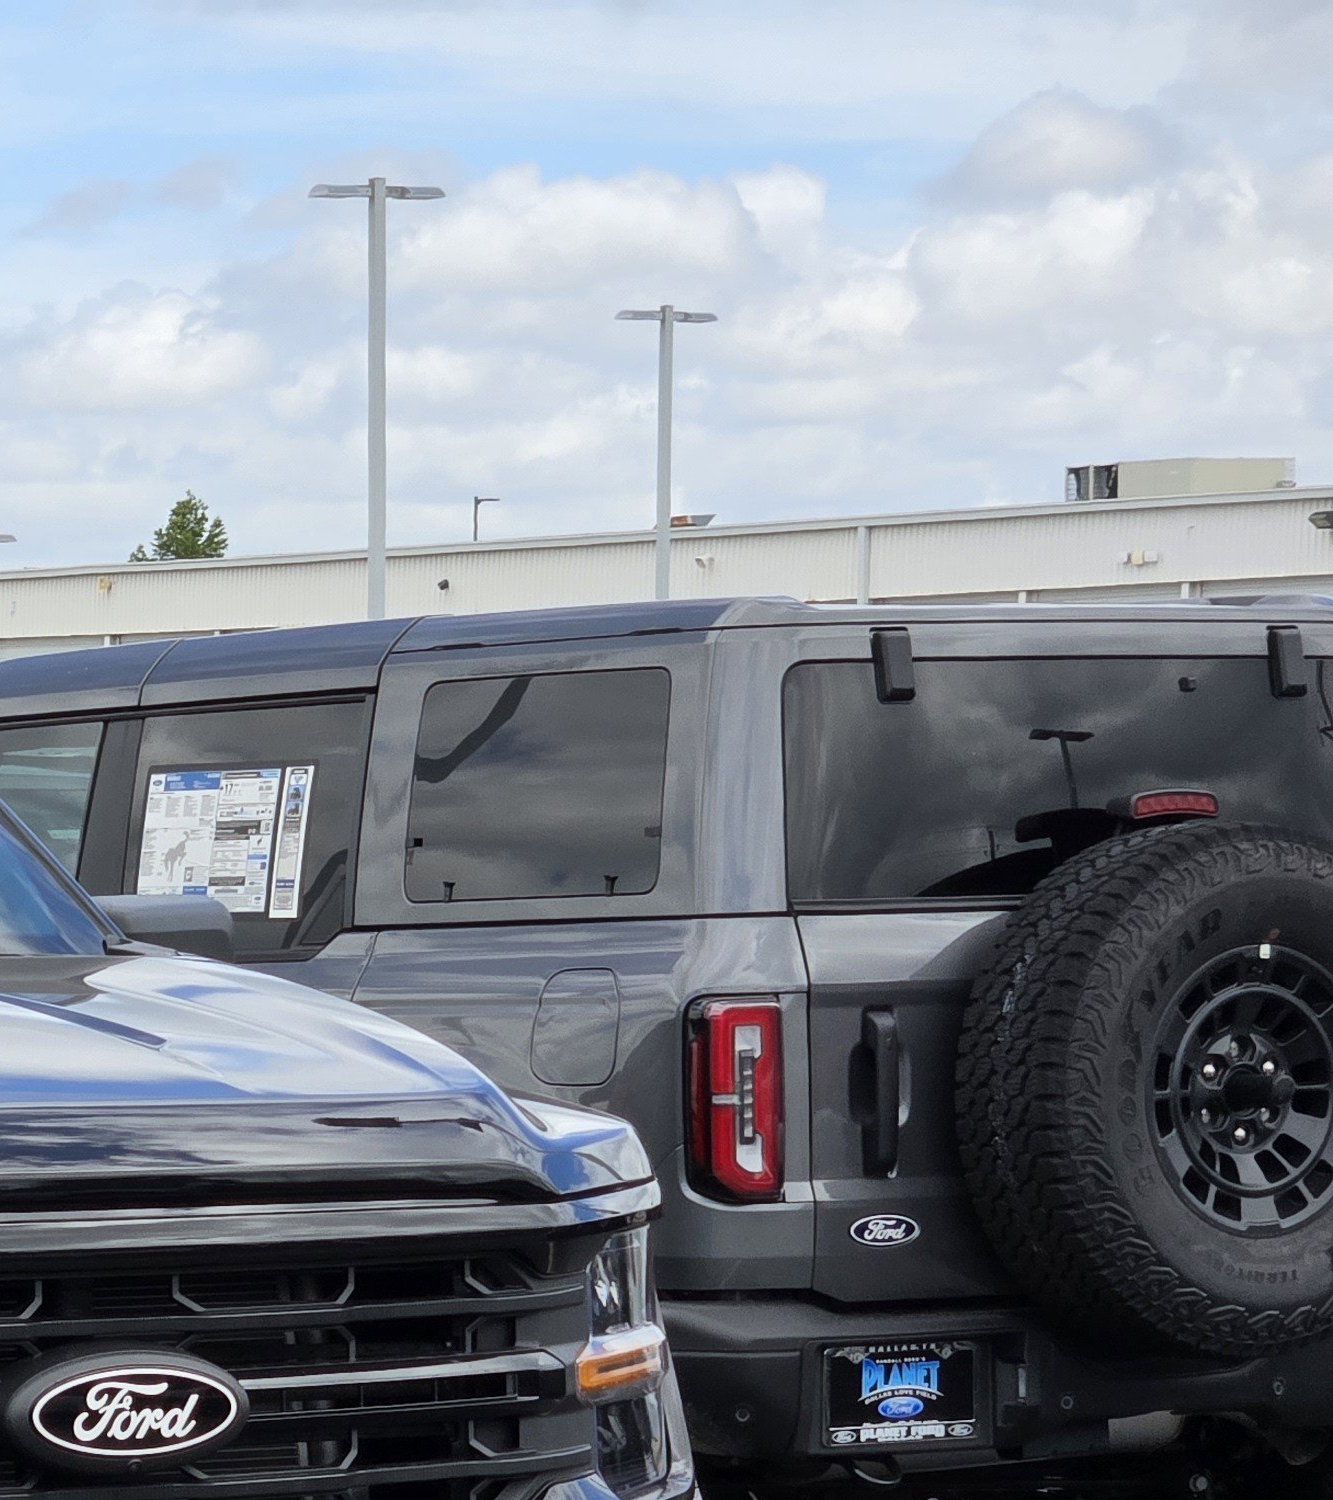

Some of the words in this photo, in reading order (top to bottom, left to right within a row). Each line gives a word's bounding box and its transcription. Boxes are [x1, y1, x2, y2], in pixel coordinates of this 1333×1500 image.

[863, 1219, 907, 1241] Ford
[862, 1356, 940, 1400] PLANET
[73, 1381, 200, 1442] Ford
